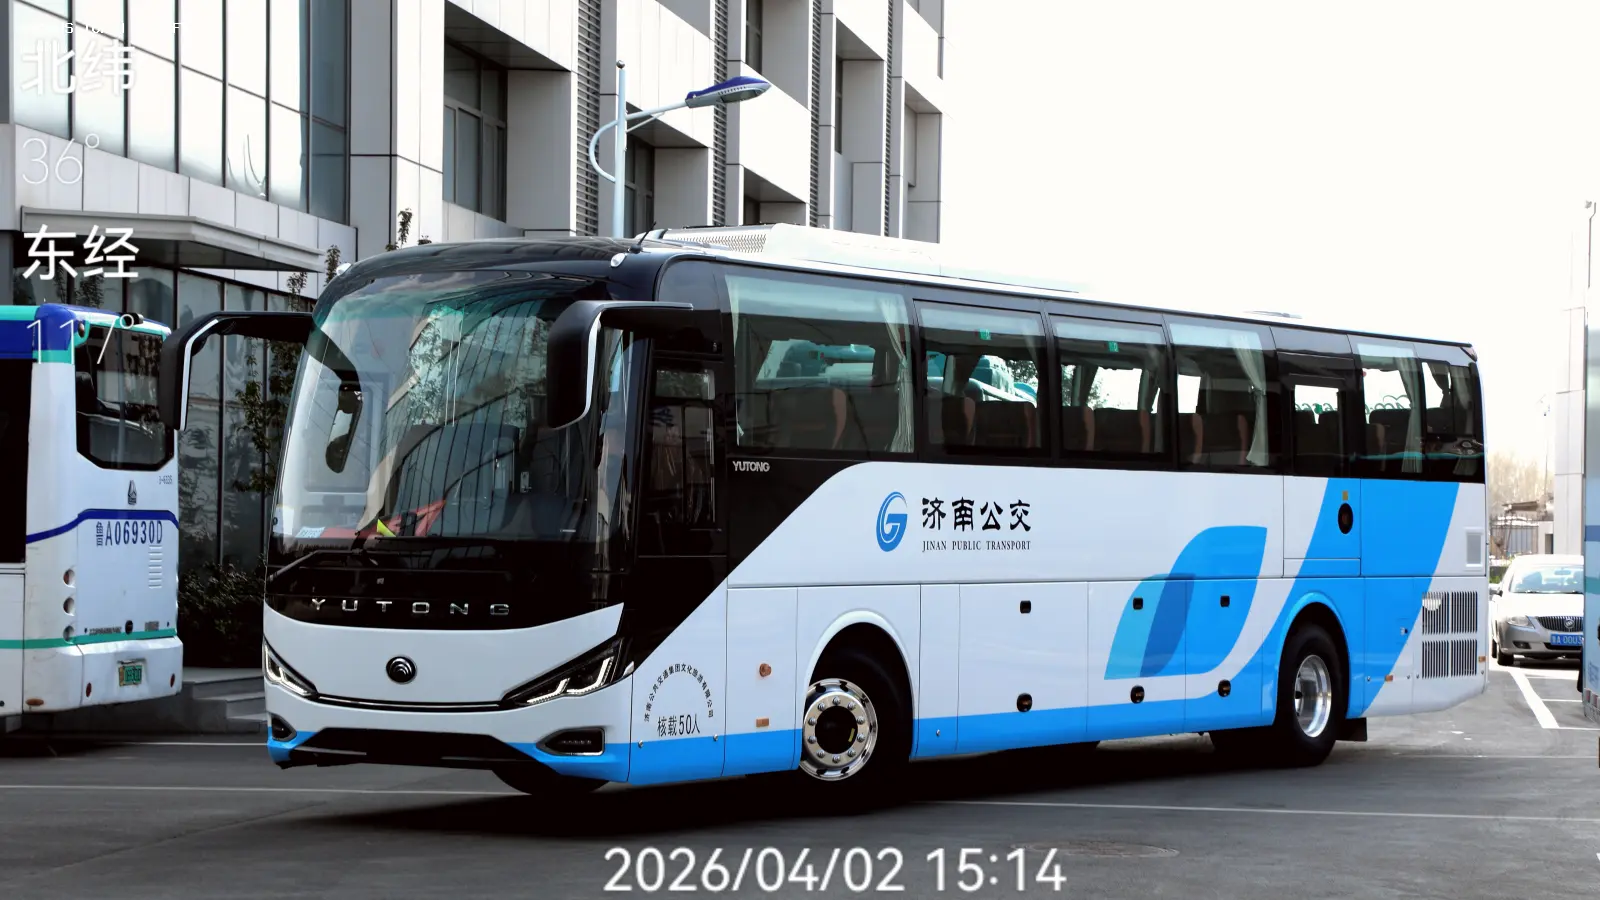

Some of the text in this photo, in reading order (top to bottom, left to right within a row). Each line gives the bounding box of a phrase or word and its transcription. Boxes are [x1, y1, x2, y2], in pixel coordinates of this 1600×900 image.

[732, 461, 770, 472] YUTONG
[921, 497, 1031, 532] 济南公交
[96, 519, 163, 547] 鲁A06930D
[922, 540, 1031, 552] JINAN PUBLIC TRANSPORT
[311, 599, 510, 616] YUTONG
[657, 713, 700, 737] 核载50人
